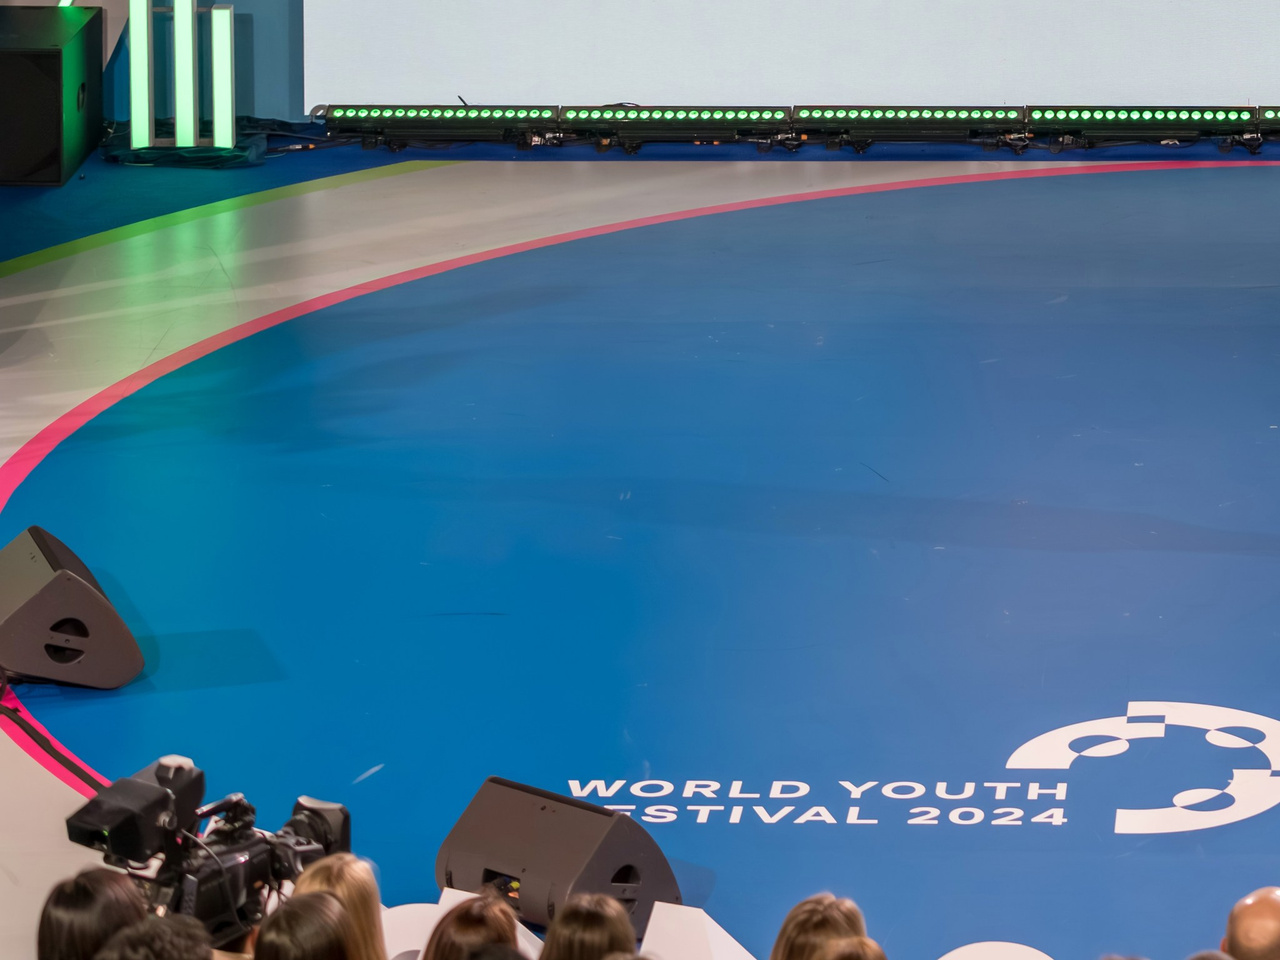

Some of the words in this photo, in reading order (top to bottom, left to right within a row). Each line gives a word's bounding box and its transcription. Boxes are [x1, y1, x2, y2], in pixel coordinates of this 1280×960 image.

[568, 779, 812, 799] WORLD
[838, 781, 1068, 801] YOUTH
[603, 805, 879, 825] STIVAL
[907, 807, 1068, 826] 2024
